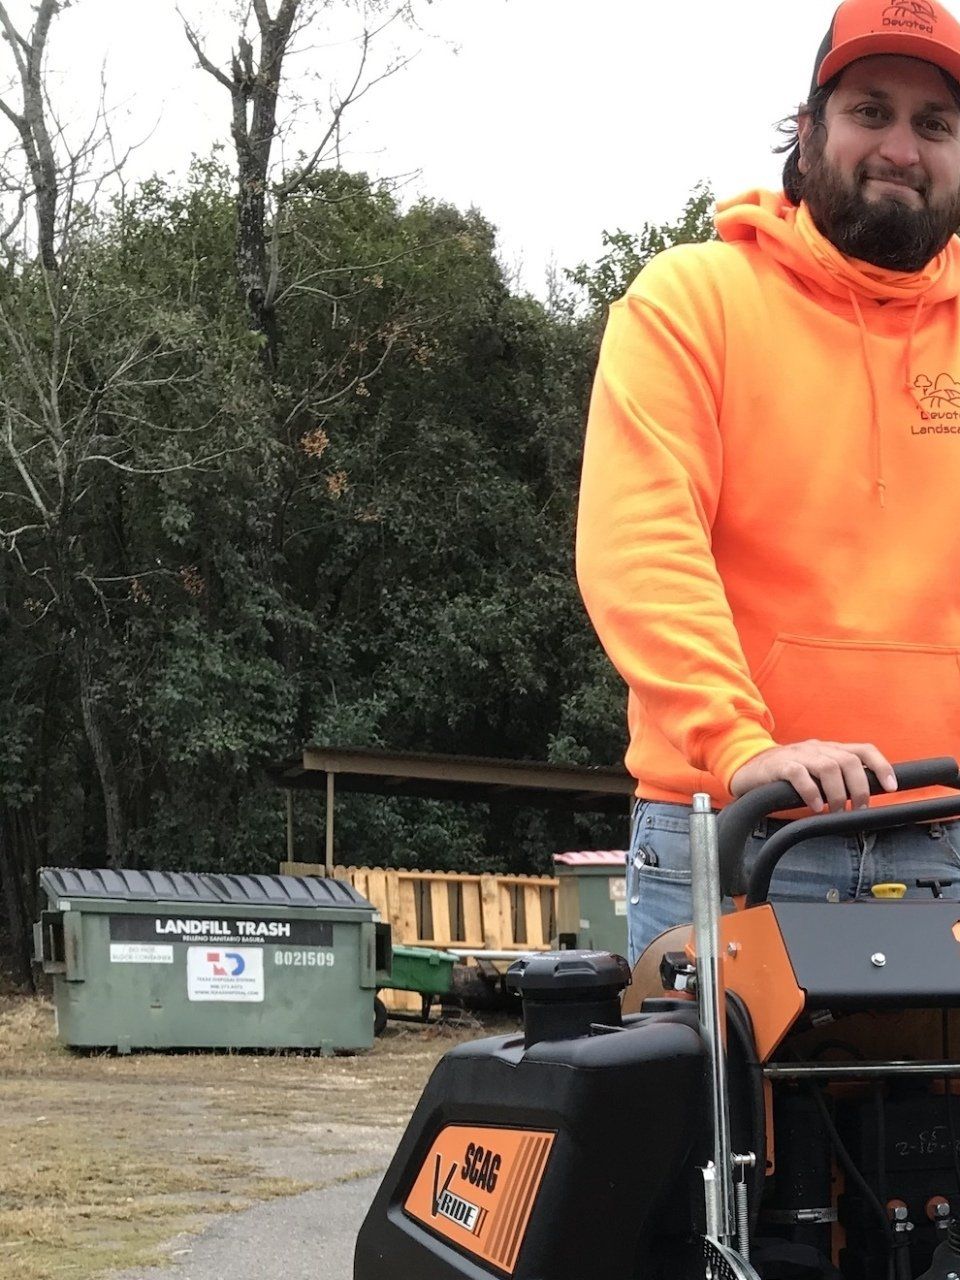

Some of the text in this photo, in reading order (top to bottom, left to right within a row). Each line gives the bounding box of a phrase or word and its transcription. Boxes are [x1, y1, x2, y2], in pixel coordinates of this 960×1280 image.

[882, 18, 933, 34] Devoted
[155, 919, 291, 937] LANDFILL TRASH
[274, 951, 335, 967] 8021509
[461, 1142, 502, 1194] SCAG
